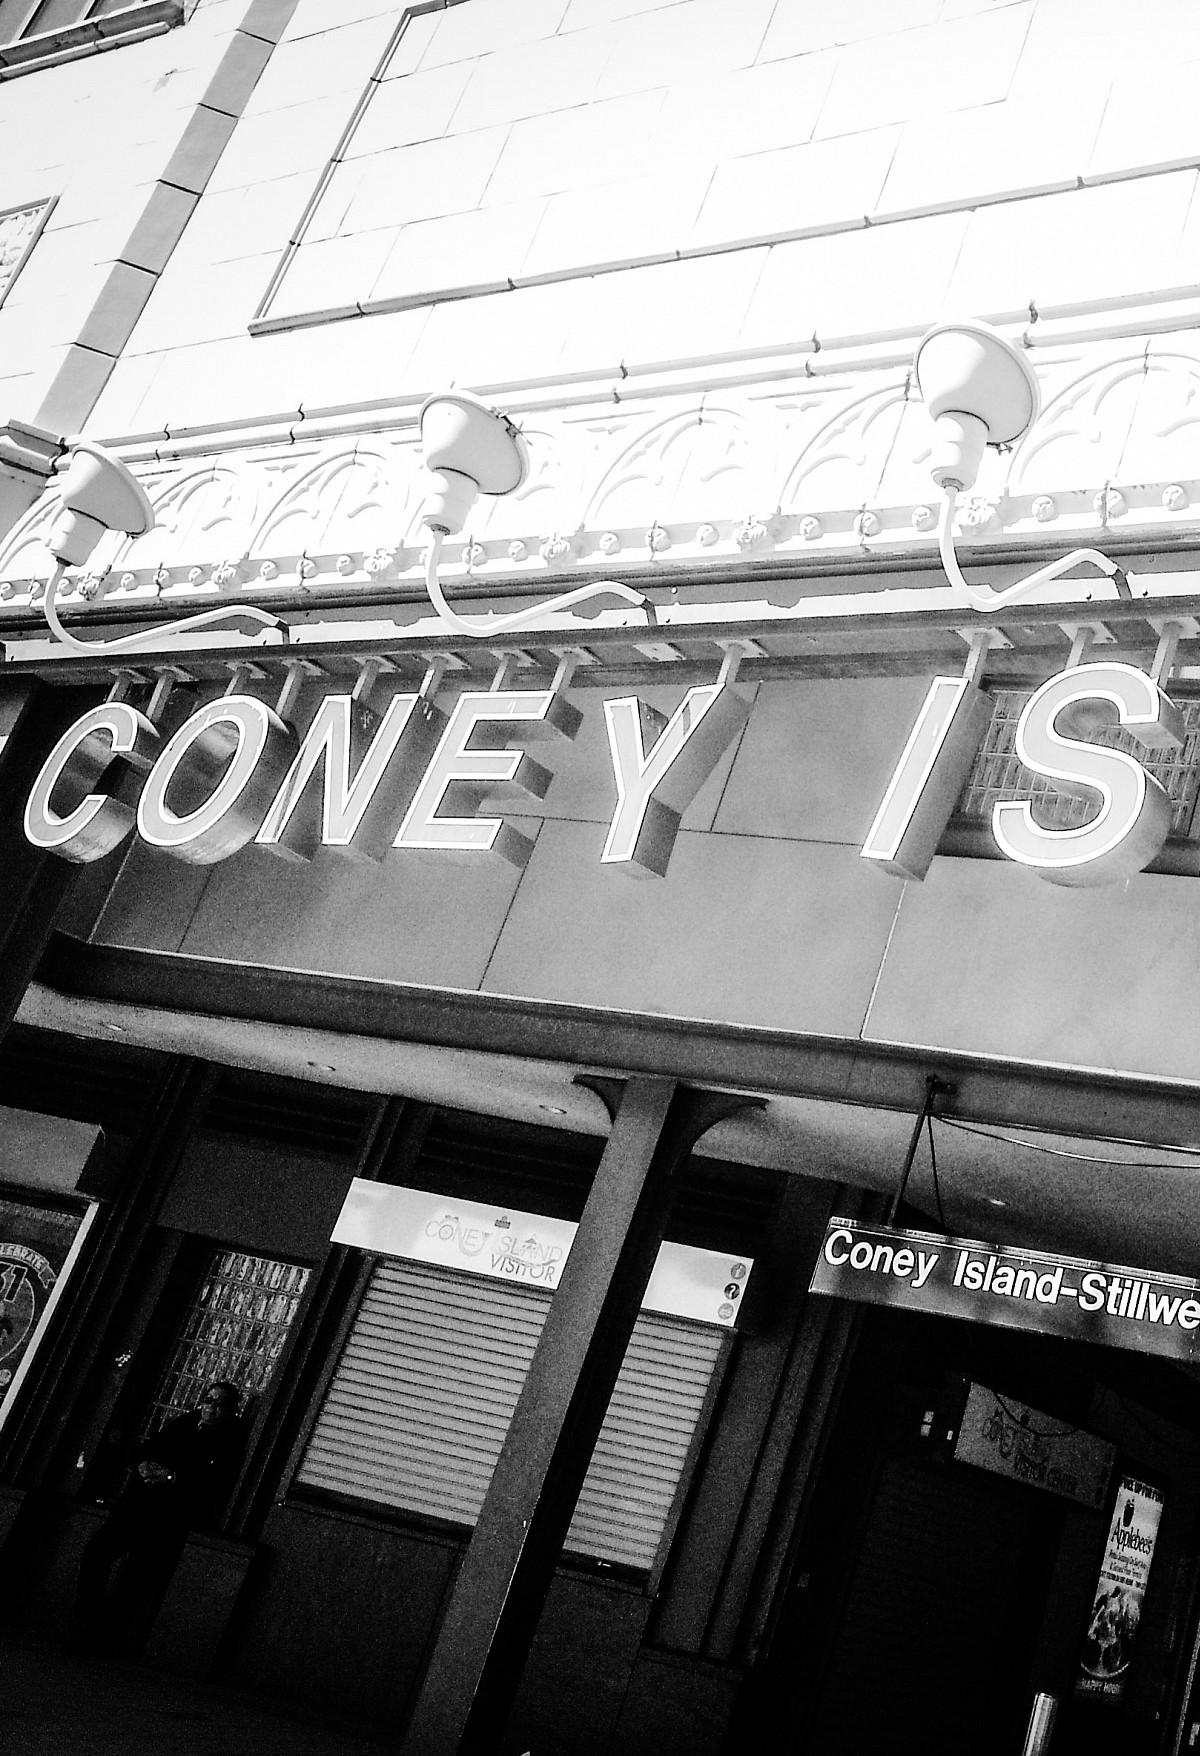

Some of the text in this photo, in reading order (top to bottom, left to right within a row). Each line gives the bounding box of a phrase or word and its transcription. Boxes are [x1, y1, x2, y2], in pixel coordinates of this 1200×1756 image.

[24, 682, 728, 864] CONEY
[490, 1253, 555, 1282] VISITOR
[498, 1233, 563, 1264] SLAND
[825, 1229, 939, 1288] Coney
